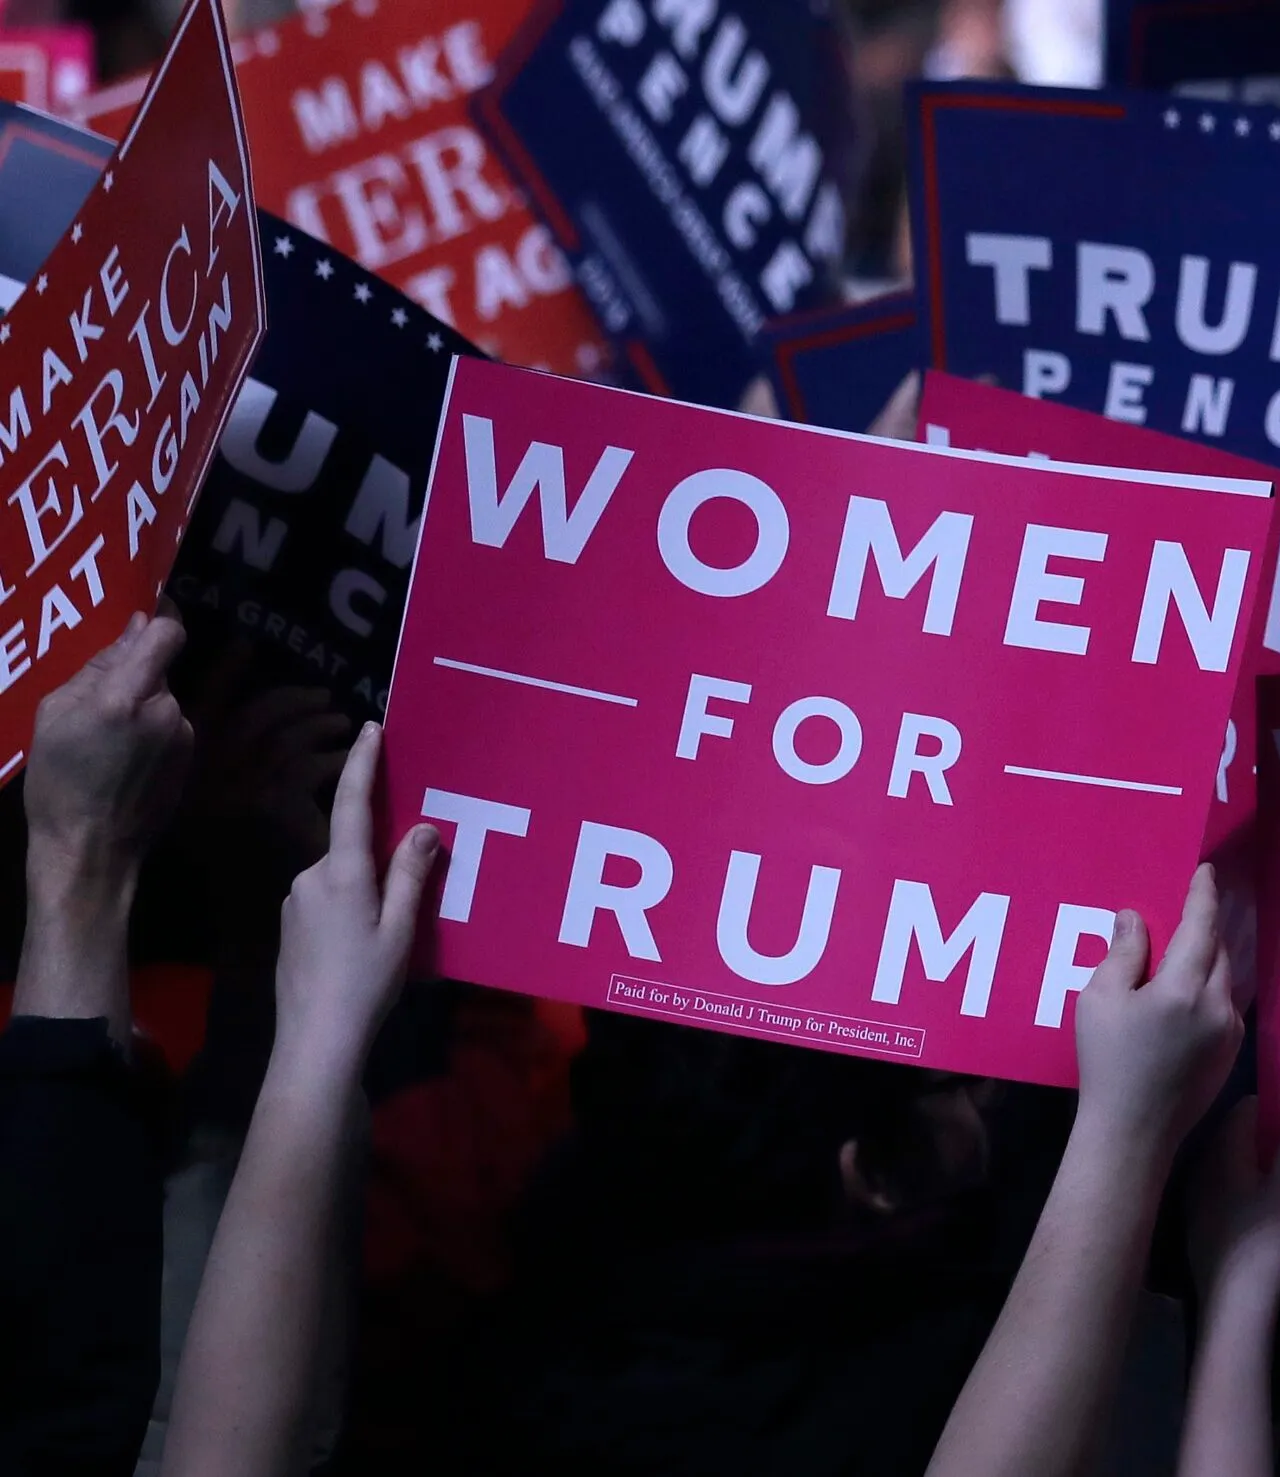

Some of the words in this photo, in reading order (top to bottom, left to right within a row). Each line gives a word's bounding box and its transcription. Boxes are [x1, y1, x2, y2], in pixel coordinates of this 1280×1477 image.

[291, 20, 495, 153] MAKE
[0, 244, 130, 467] MAKE
[0, 159, 242, 606] ERICA
[0, 533, 105, 694] EAT
[126, 272, 232, 562] AGAIN
[463, 413, 1251, 672] WOMEN
[675, 673, 963, 806] FOR
[421, 788, 1117, 1029] TRUMP
[615, 981, 645, 1000] Paid
[649, 988, 669, 1004] for
[672, 993, 690, 1010] by
[694, 997, 743, 1018] Donald
[746, 1006, 754, 1020] J
[758, 1010, 801, 1030] Trump
[805, 1017, 825, 1033] for
[828, 1022, 890, 1046] President,
[894, 1033, 918, 1049] Inc.
